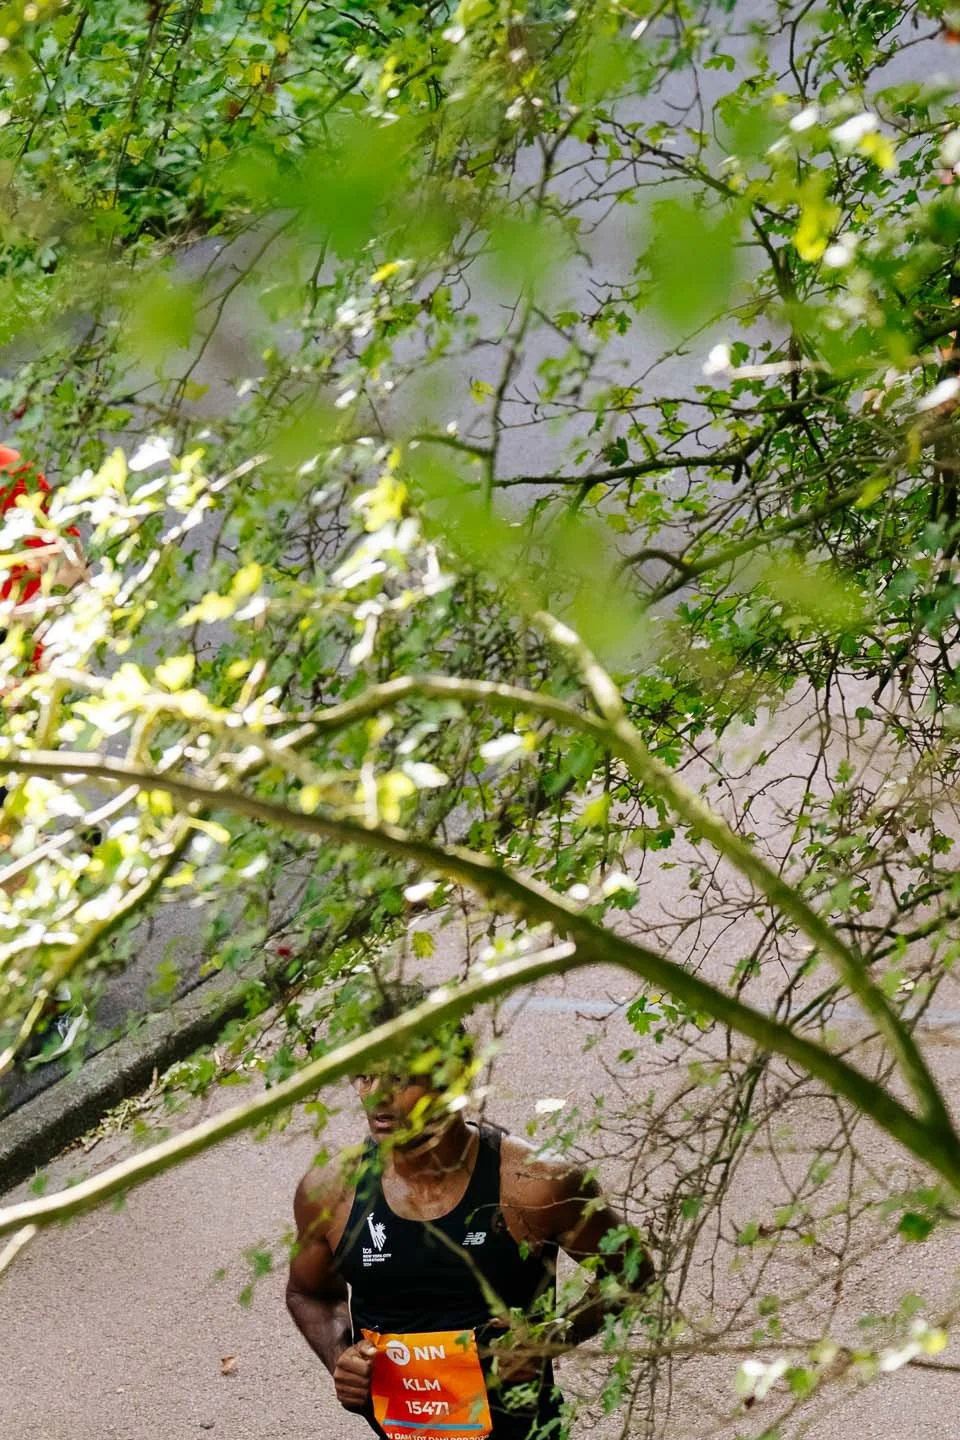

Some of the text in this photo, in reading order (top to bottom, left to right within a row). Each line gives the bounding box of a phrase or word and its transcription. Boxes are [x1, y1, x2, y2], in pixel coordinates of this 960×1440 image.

[413, 1344, 446, 1361] NN
[402, 1377, 441, 1392] KLM
[405, 1400, 450, 1416] 15471
